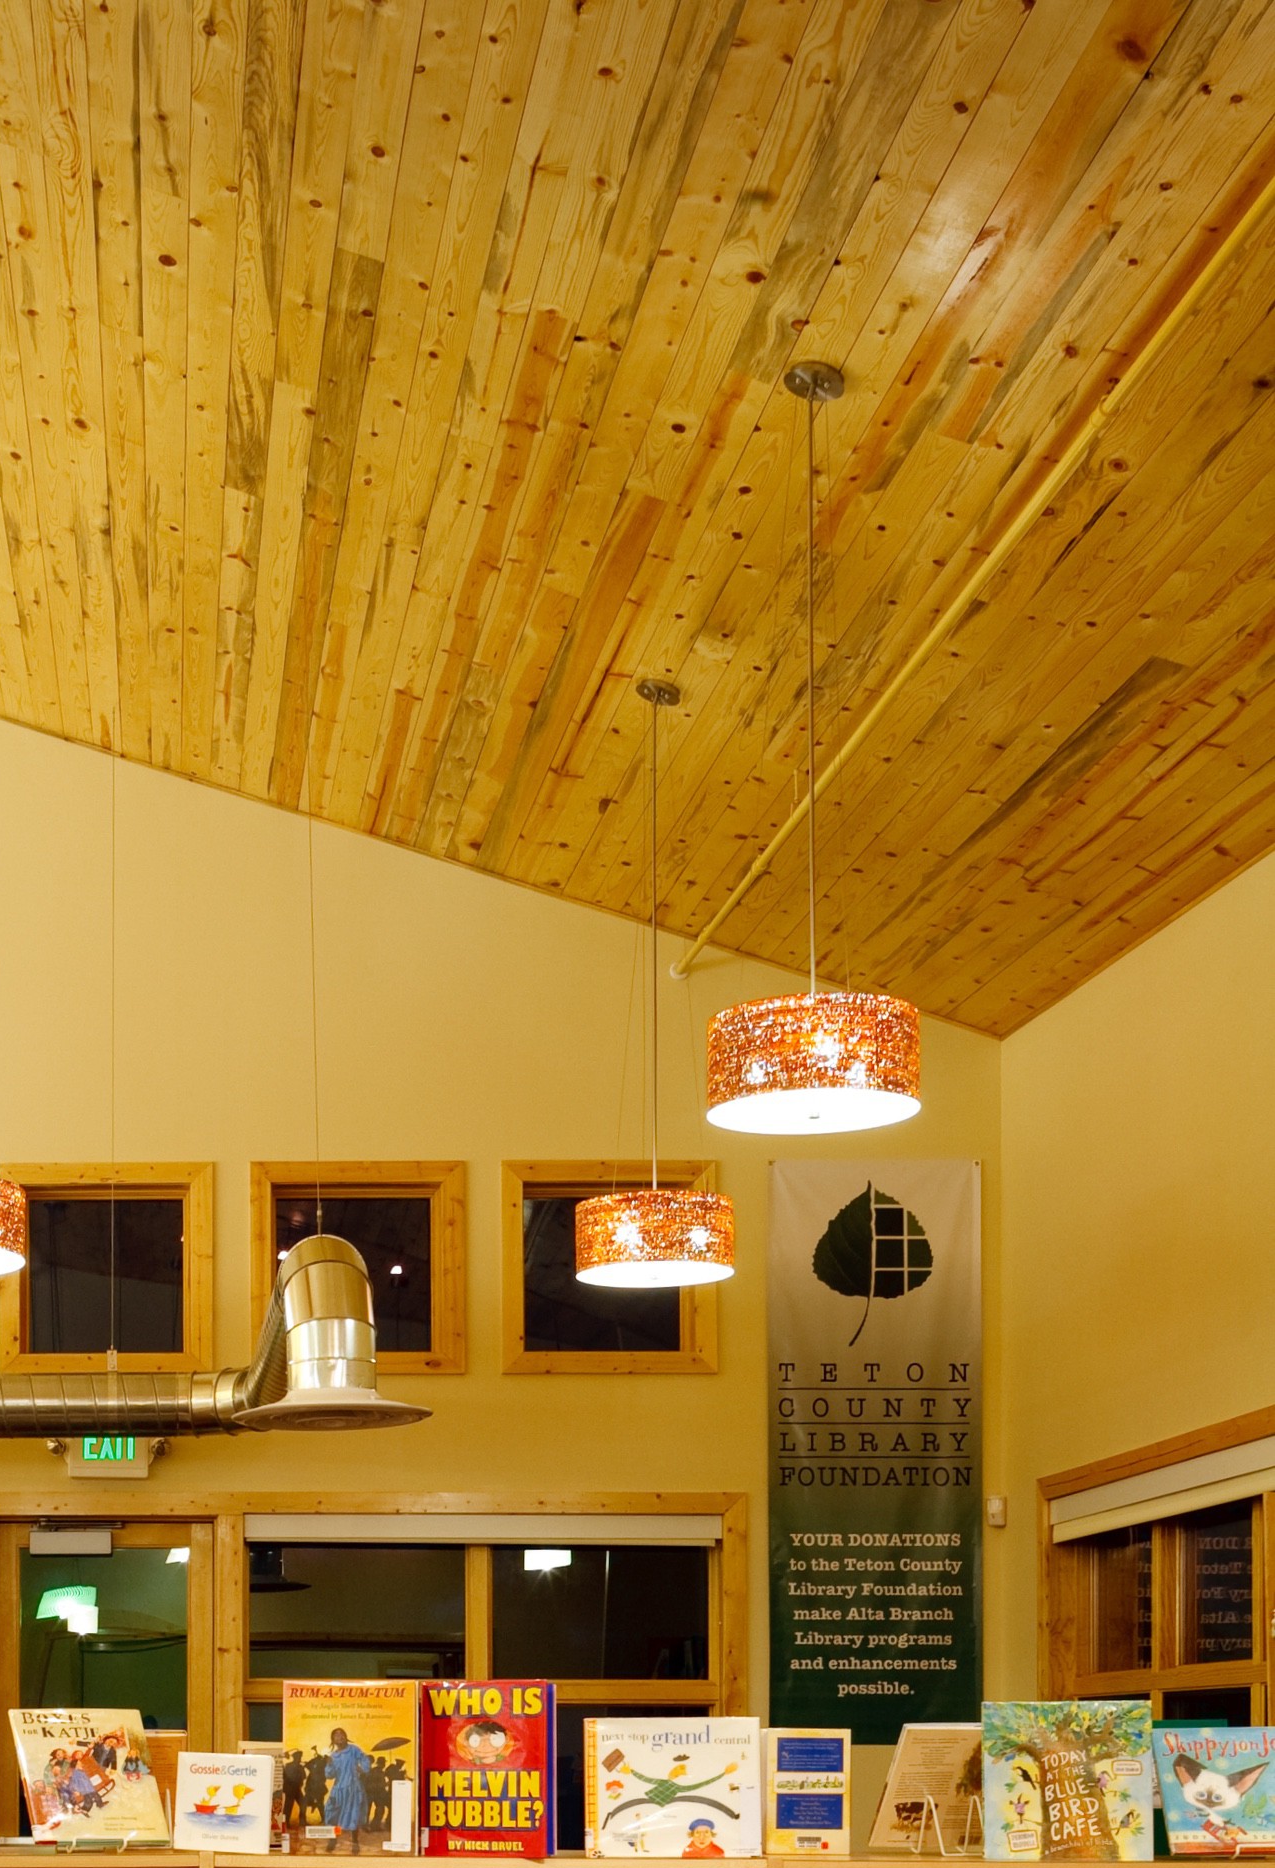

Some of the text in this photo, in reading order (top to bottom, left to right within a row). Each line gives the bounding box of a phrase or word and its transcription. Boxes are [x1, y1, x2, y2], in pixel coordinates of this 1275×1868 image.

[778, 1363, 970, 1383] TETON
[778, 1398, 972, 1418] COUNTY
[779, 1432, 969, 1453] LIBRARY
[778, 1466, 973, 1488] FOUNDATION
[790, 1533, 962, 1547] YOUR DONATIONS
[789, 1558, 962, 1576] to the Teton County
[788, 1582, 963, 1602] Library Foundation
[793, 1607, 954, 1622] make Alta Branch
[794, 1632, 953, 1652] Library programs
[790, 1656, 958, 1671] and enhancements
[290, 1688, 406, 1698] RUM-A-TUM-TUM
[838, 1681, 915, 1698] possible.
[429, 1688, 542, 1716] WHO IS
[601, 1724, 750, 1752] next stop grand central
[1162, 1732, 1258, 1760] Skippyjon
[1041, 1751, 1086, 1770] TODAY
[429, 1770, 540, 1798] MELVIN
[1046, 1766, 1086, 1782] AT THE
[1044, 1781, 1096, 1802] BLUE-
[429, 1800, 544, 1828] BUBBLE?
[1049, 1798, 1100, 1822] BIRD
[1051, 1818, 1102, 1840] CAFÉ
[448, 1841, 524, 1852] BY NICK BRUEL
